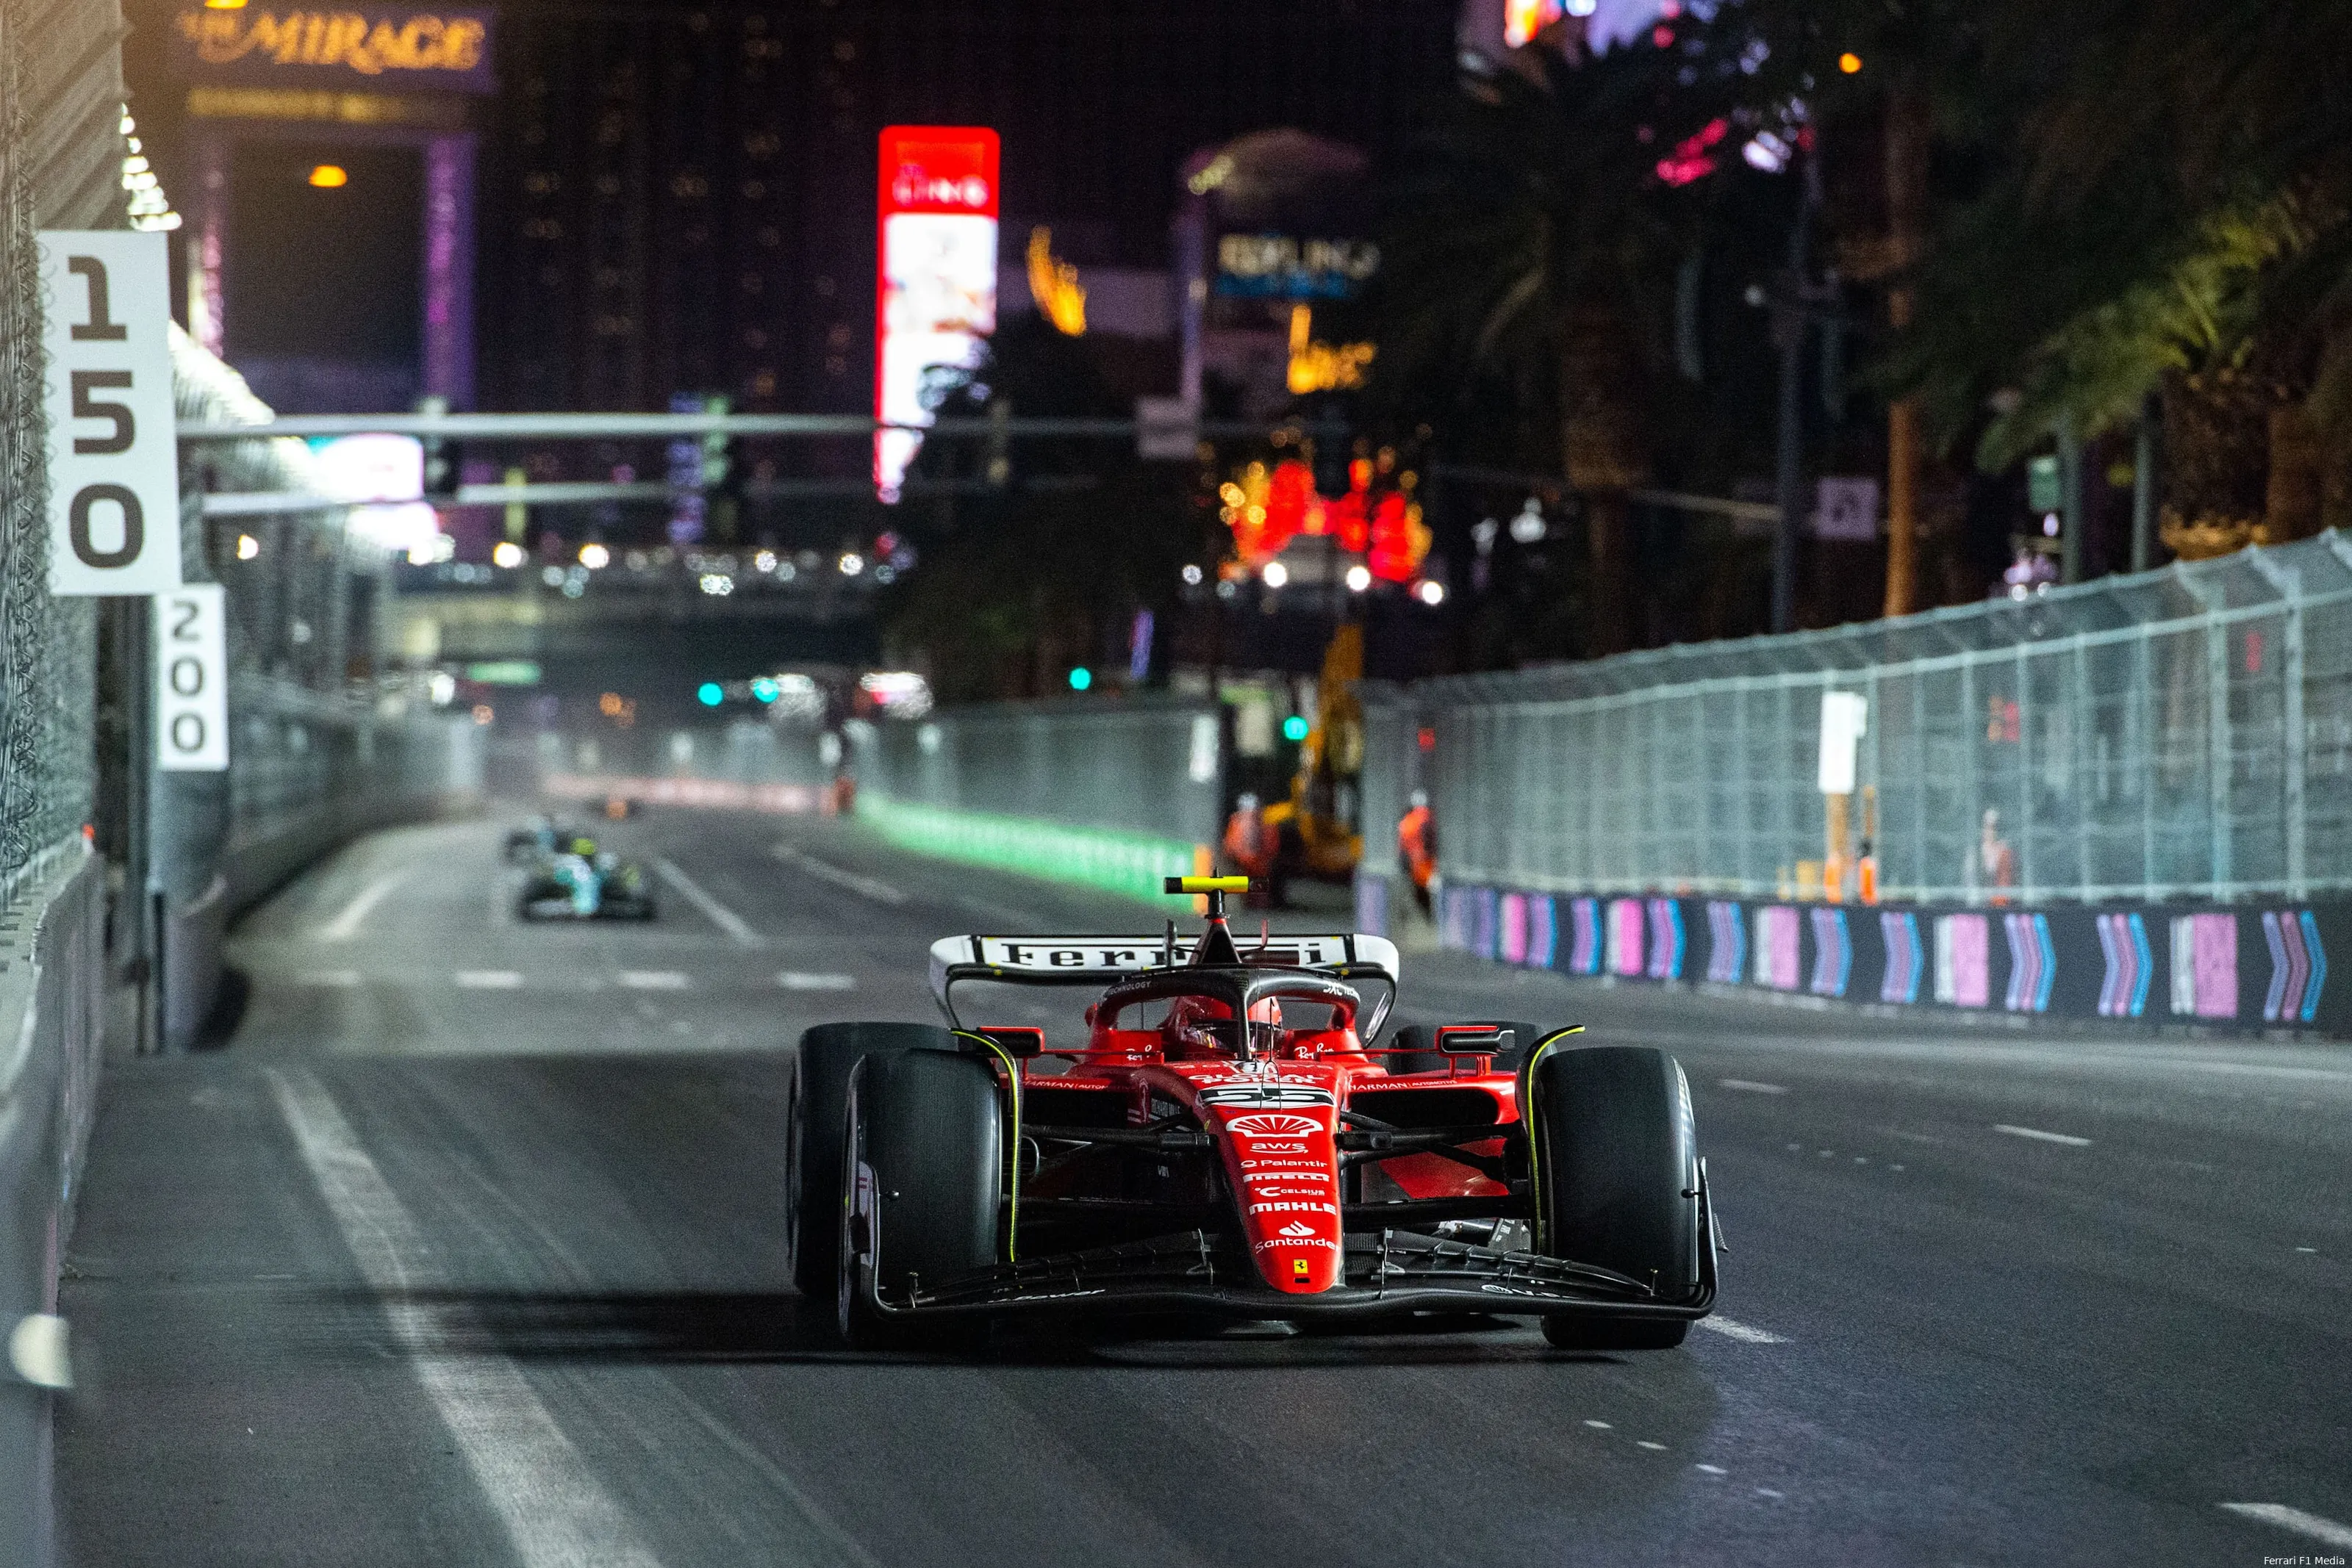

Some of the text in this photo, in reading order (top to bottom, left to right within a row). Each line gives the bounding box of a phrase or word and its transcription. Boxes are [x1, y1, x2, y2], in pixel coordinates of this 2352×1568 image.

[255, 10, 485, 74] MIRAGE
[68, 254, 146, 570] 150
[169, 600, 207, 754] 200
[1348, 1082, 1408, 1090] HARMAN
[1198, 1087, 1335, 1107] 55
[1261, 1159, 1327, 1168] Palantir
[1242, 1172, 1330, 1183] PIRELLI
[1250, 1201, 1336, 1215] MAHLE
